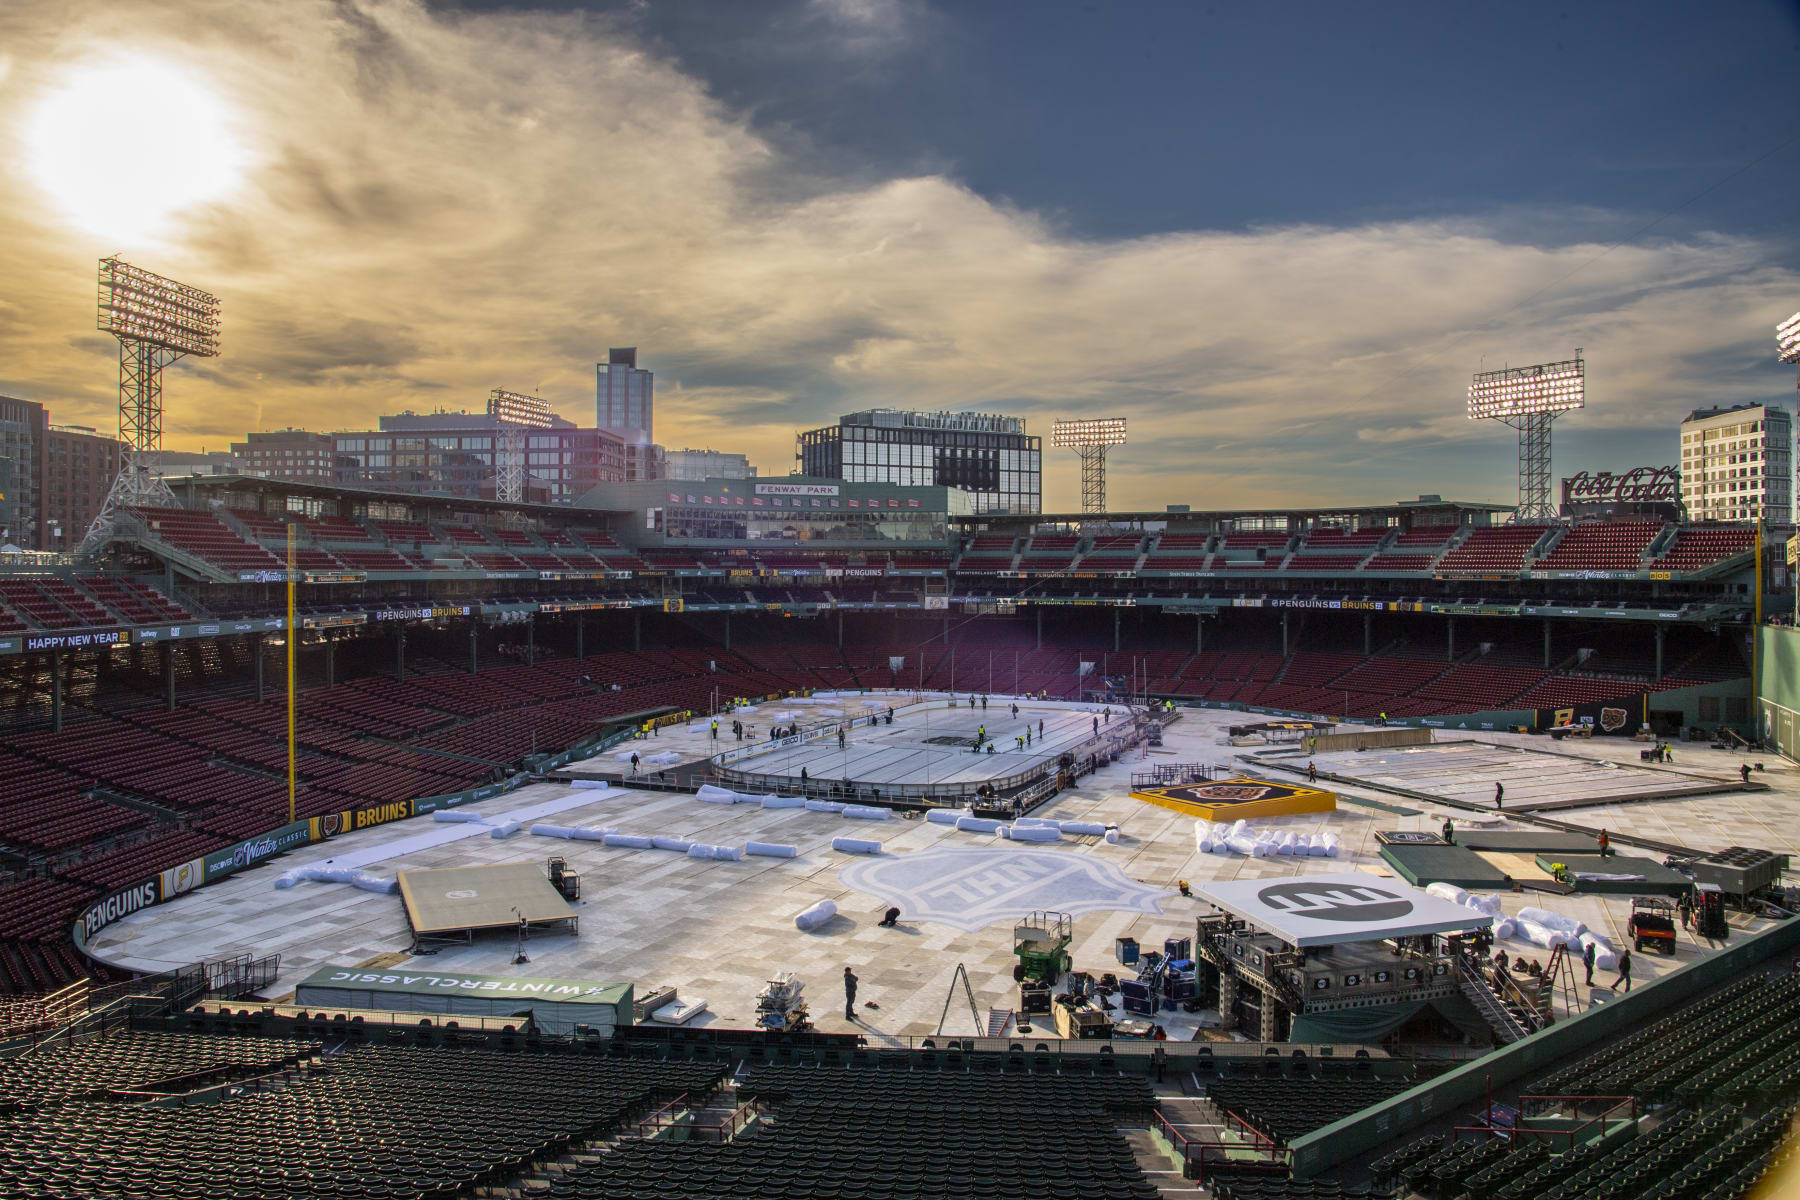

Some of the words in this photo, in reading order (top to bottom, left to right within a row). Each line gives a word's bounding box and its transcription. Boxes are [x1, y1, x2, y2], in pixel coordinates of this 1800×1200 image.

[1583, 569, 1609, 579] Winter
[382, 609, 421, 620] PENGUINS
[432, 607, 463, 617] BRUINS
[1279, 600, 1328, 608] PENGUINS
[1342, 602, 1375, 610] BRUINS
[28, 637, 65, 649] HAPPY
[67, 635, 91, 646] NEW
[93, 632, 119, 643] YEAR
[781, 735, 799, 746] GEICO
[356, 801, 408, 828] BRUINS
[209, 858, 232, 873] DISCOVER
[243, 837, 278, 866] Winter
[278, 829, 308, 846] CLASSIC
[926, 855, 1050, 902] NHL
[85, 881, 156, 938] PENGUINS
[329, 971, 604, 996] #WINTERCLASSIC
